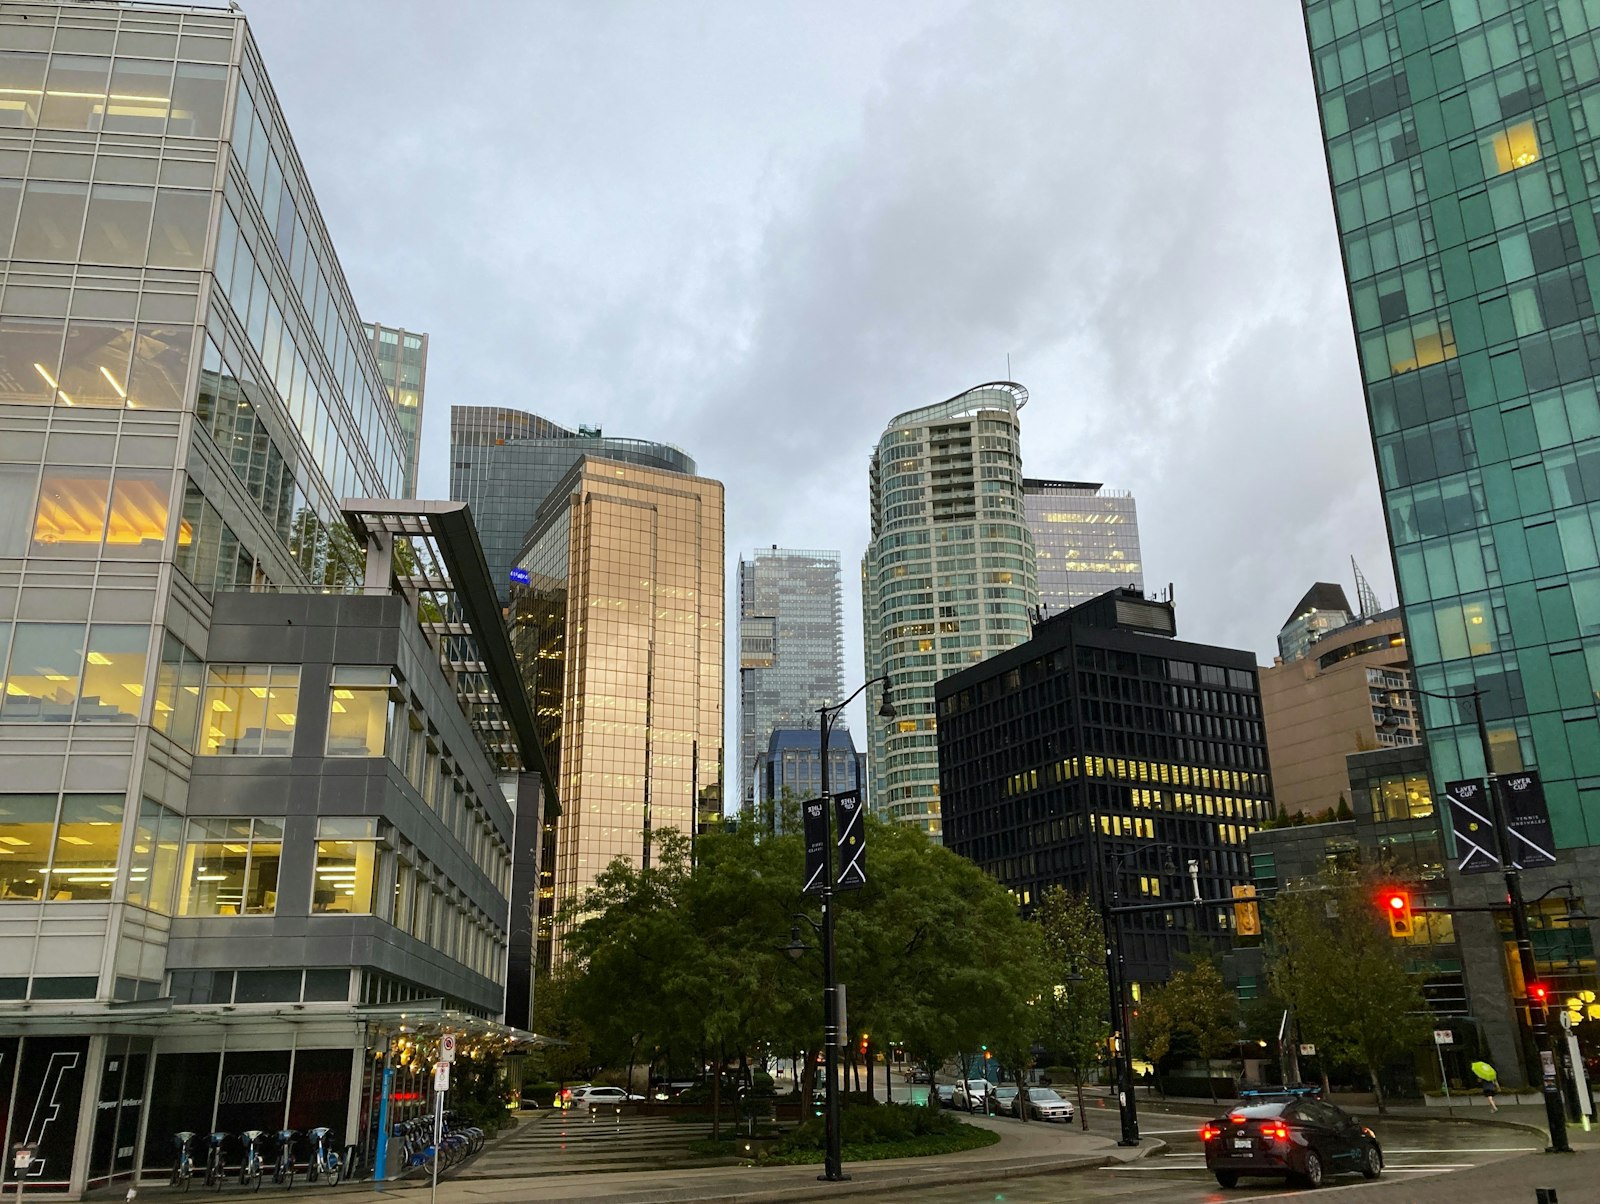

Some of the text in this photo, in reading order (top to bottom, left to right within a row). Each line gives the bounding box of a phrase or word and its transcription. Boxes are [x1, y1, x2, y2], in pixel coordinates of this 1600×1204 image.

[1508, 777, 1531, 787] LAVER
[1455, 785, 1477, 794] LAVER
[220, 1073, 287, 1104] STRONGER
